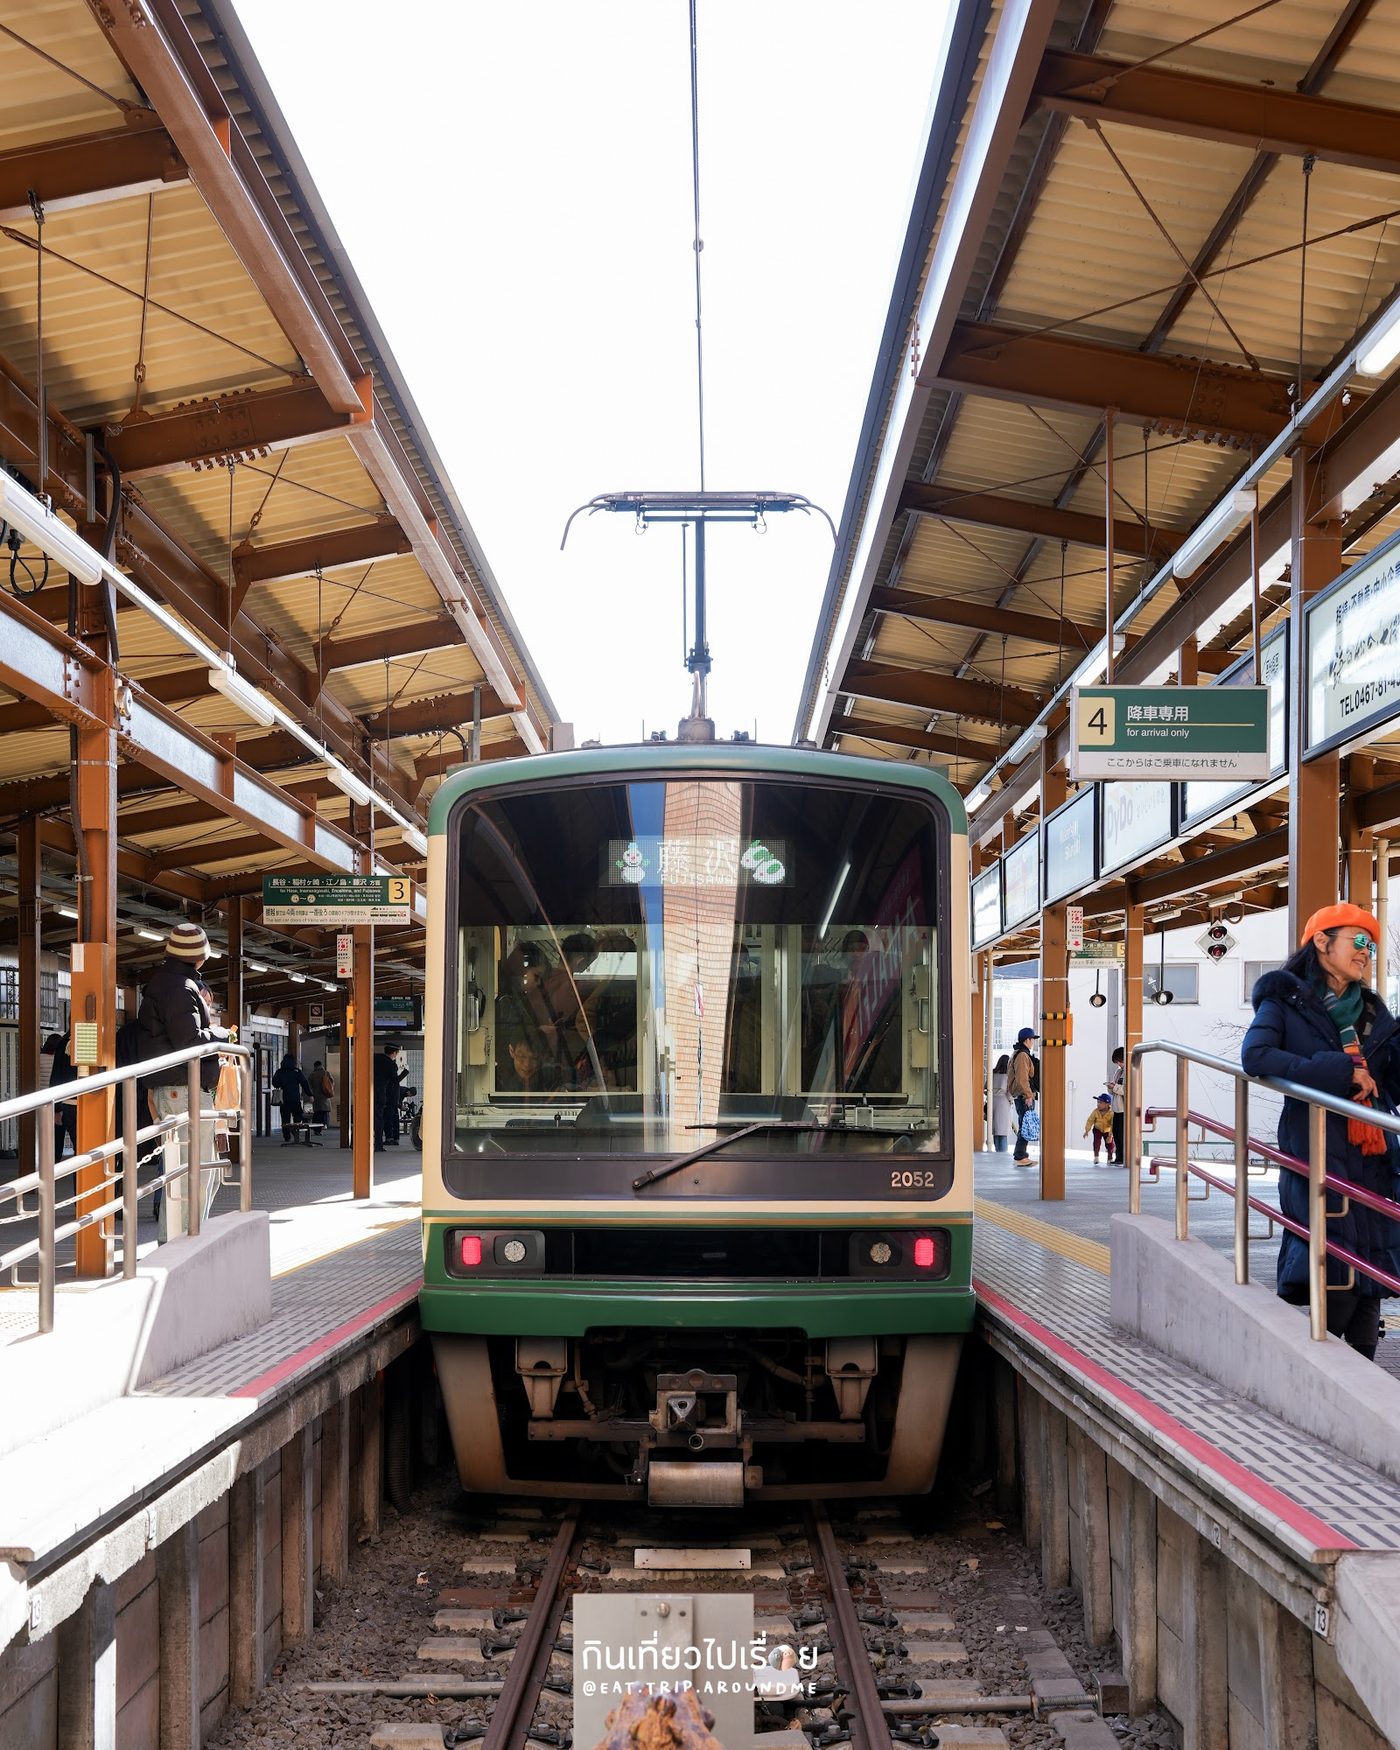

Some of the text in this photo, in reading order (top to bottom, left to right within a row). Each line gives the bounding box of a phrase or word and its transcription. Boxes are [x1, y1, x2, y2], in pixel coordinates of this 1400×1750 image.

[1087, 707, 1108, 736] 4
[1127, 705, 1189, 722] 降車専用
[1126, 728, 1190, 739] for arrival only
[1107, 757, 1238, 768] ここからはご乗車になれません
[660, 874, 734, 885] FUJISAWA
[393, 881, 404, 899] 3
[891, 1171, 934, 1187] 2052
[1317, 1609, 1327, 1632] 13
